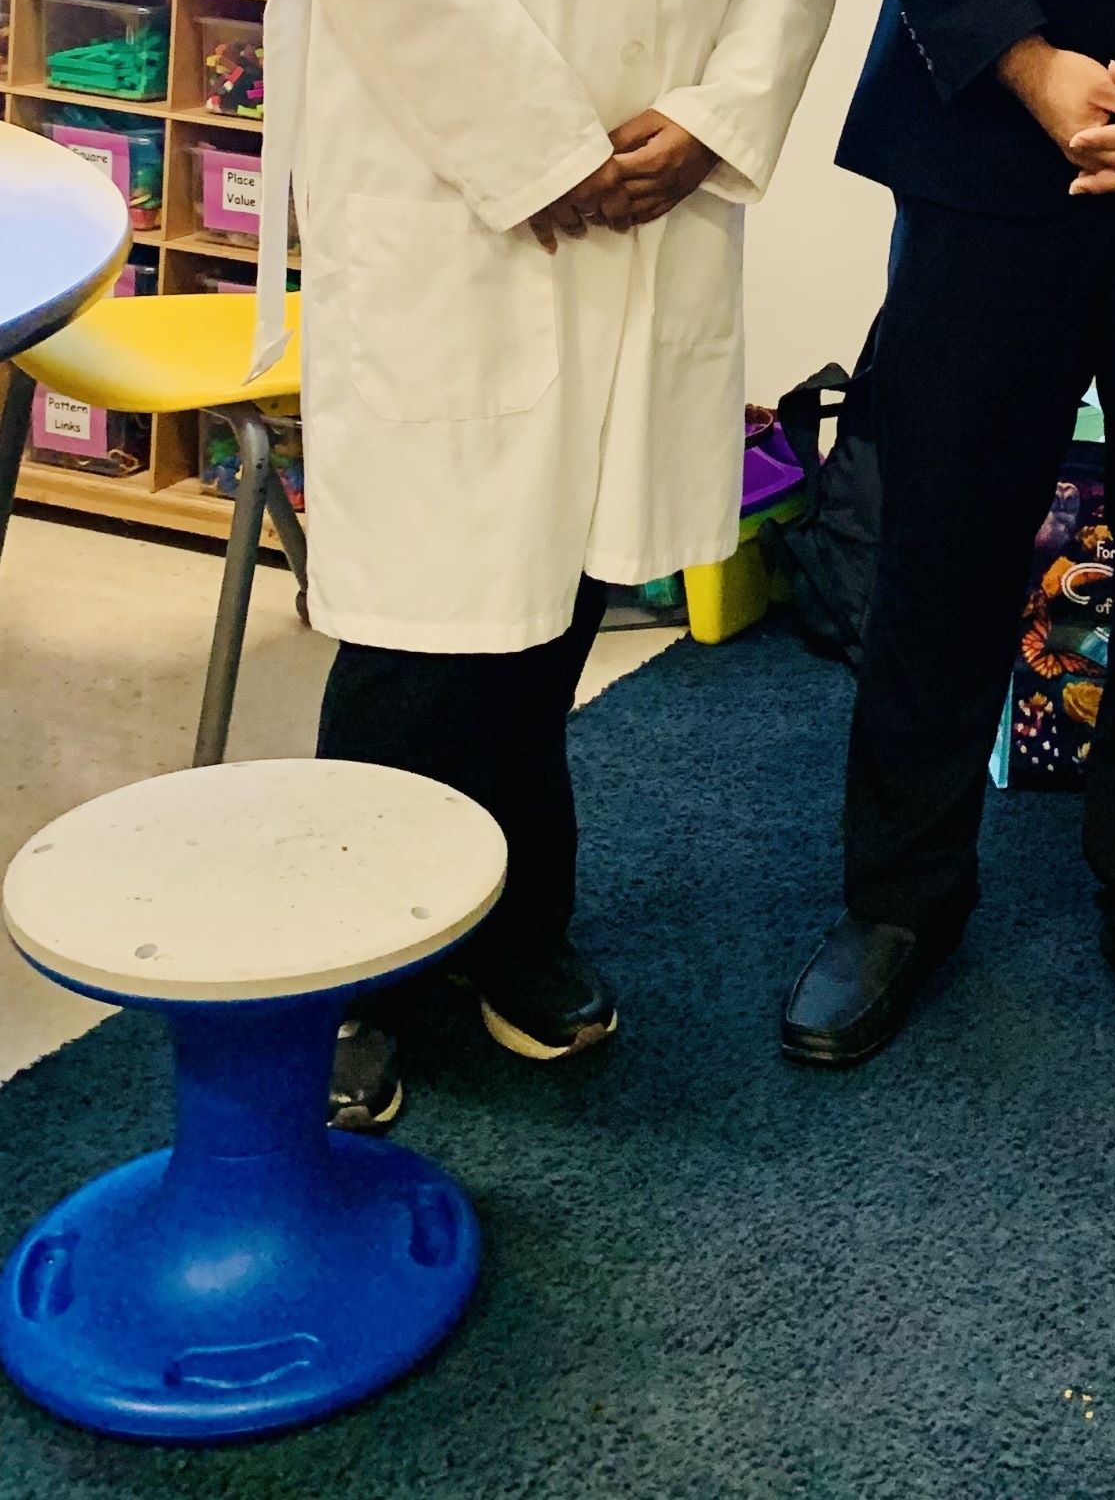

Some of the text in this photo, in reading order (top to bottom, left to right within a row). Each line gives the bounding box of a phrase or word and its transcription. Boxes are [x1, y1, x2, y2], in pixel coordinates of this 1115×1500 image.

[227, 171, 255, 186] Place
[226, 193, 256, 207] Value
[48, 396, 88, 414] Pattern
[55, 418, 81, 432] Links
[1095, 598, 1113, 614] of
